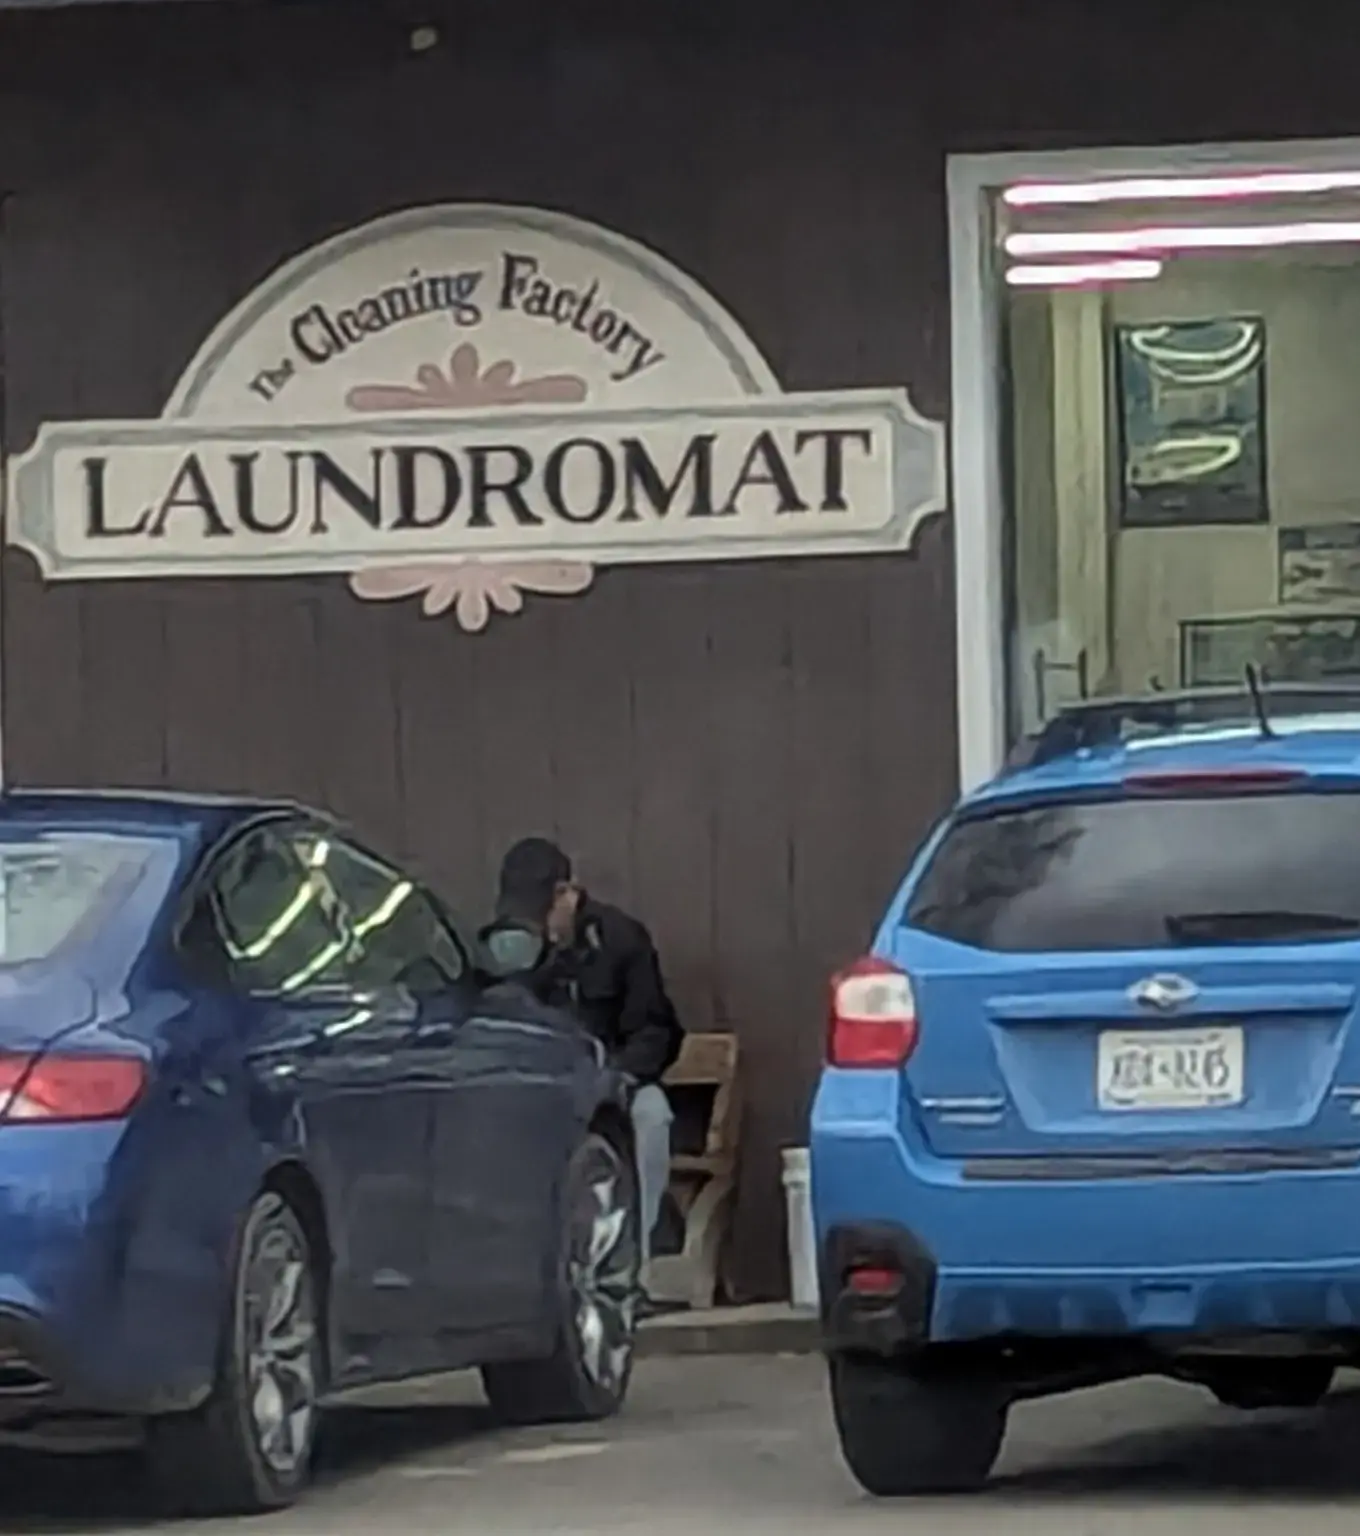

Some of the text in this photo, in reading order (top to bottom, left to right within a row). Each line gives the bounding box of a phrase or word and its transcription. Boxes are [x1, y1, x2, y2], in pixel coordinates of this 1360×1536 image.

[249, 250, 666, 402] The Cleaning Factory
[80, 427, 874, 540] LAUNDROMAT
